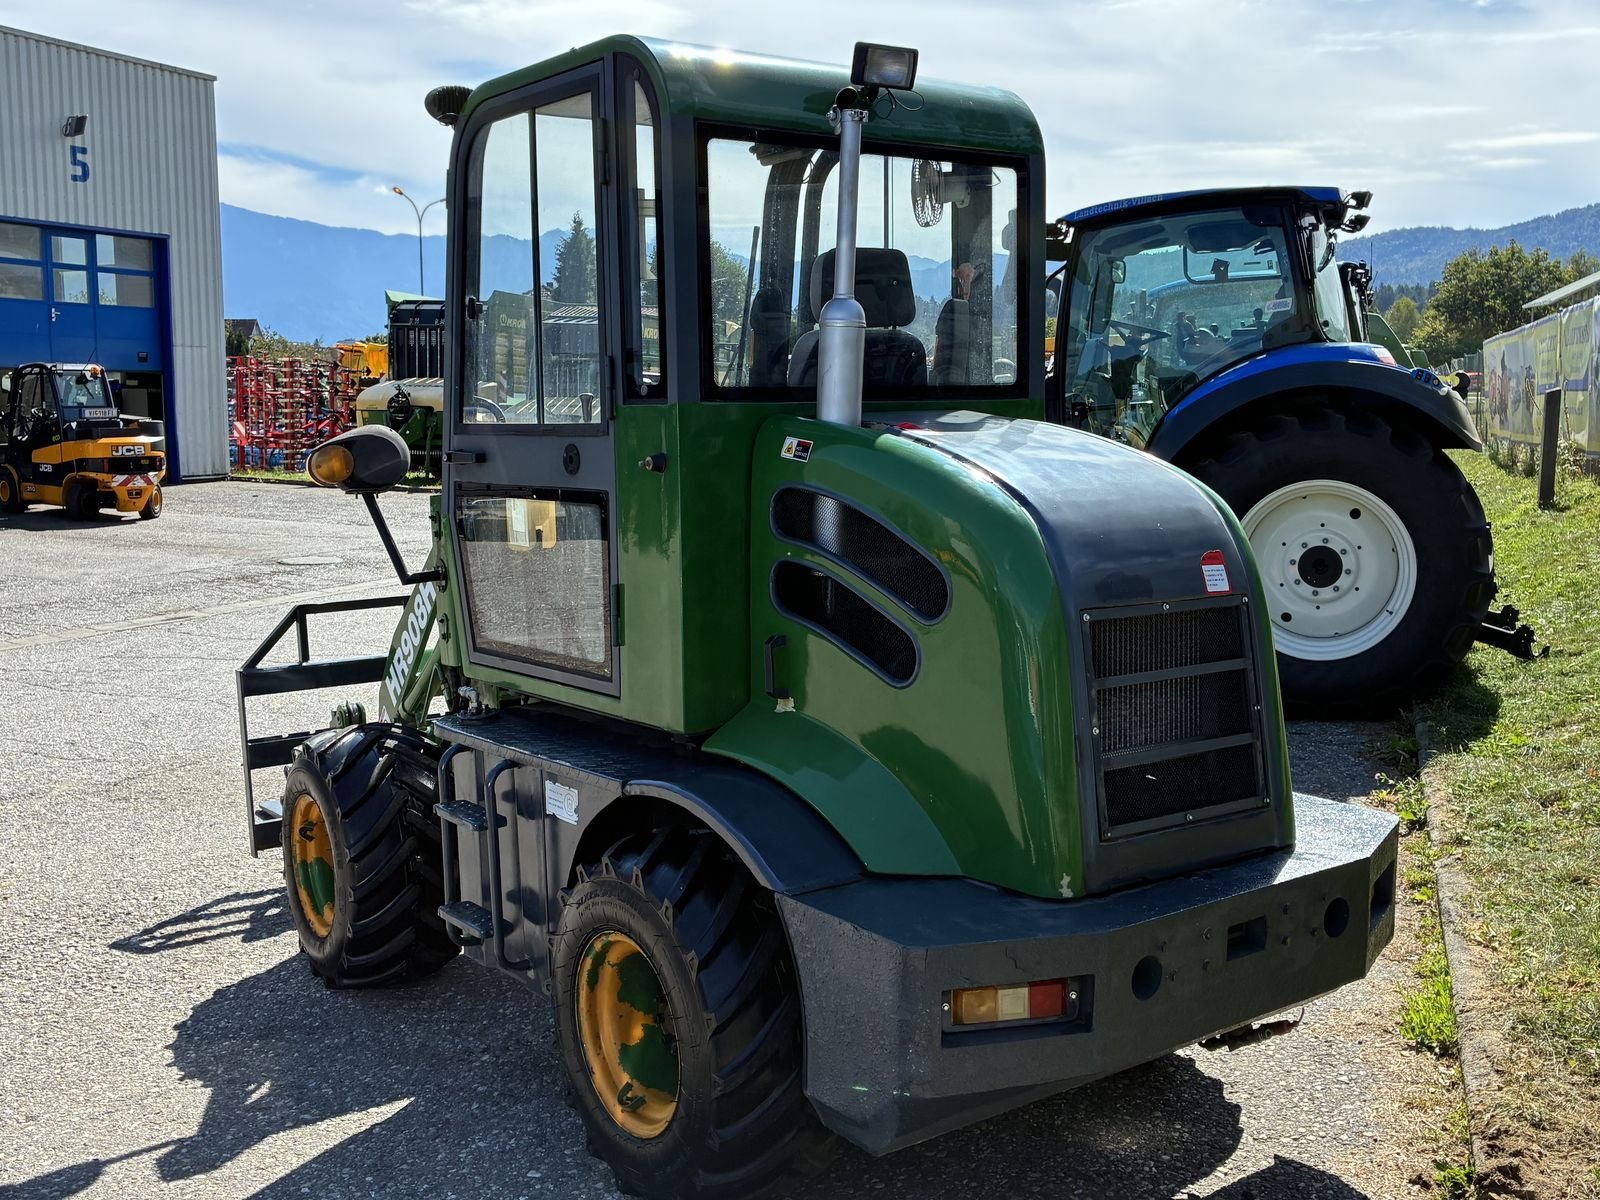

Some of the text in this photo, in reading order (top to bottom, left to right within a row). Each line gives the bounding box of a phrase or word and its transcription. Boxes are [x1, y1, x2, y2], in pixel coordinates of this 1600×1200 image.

[70, 145, 90, 182] 5
[112, 445, 145, 456] JCB
[40, 464, 52, 472] JCB
[384, 581, 437, 707] HR908H
